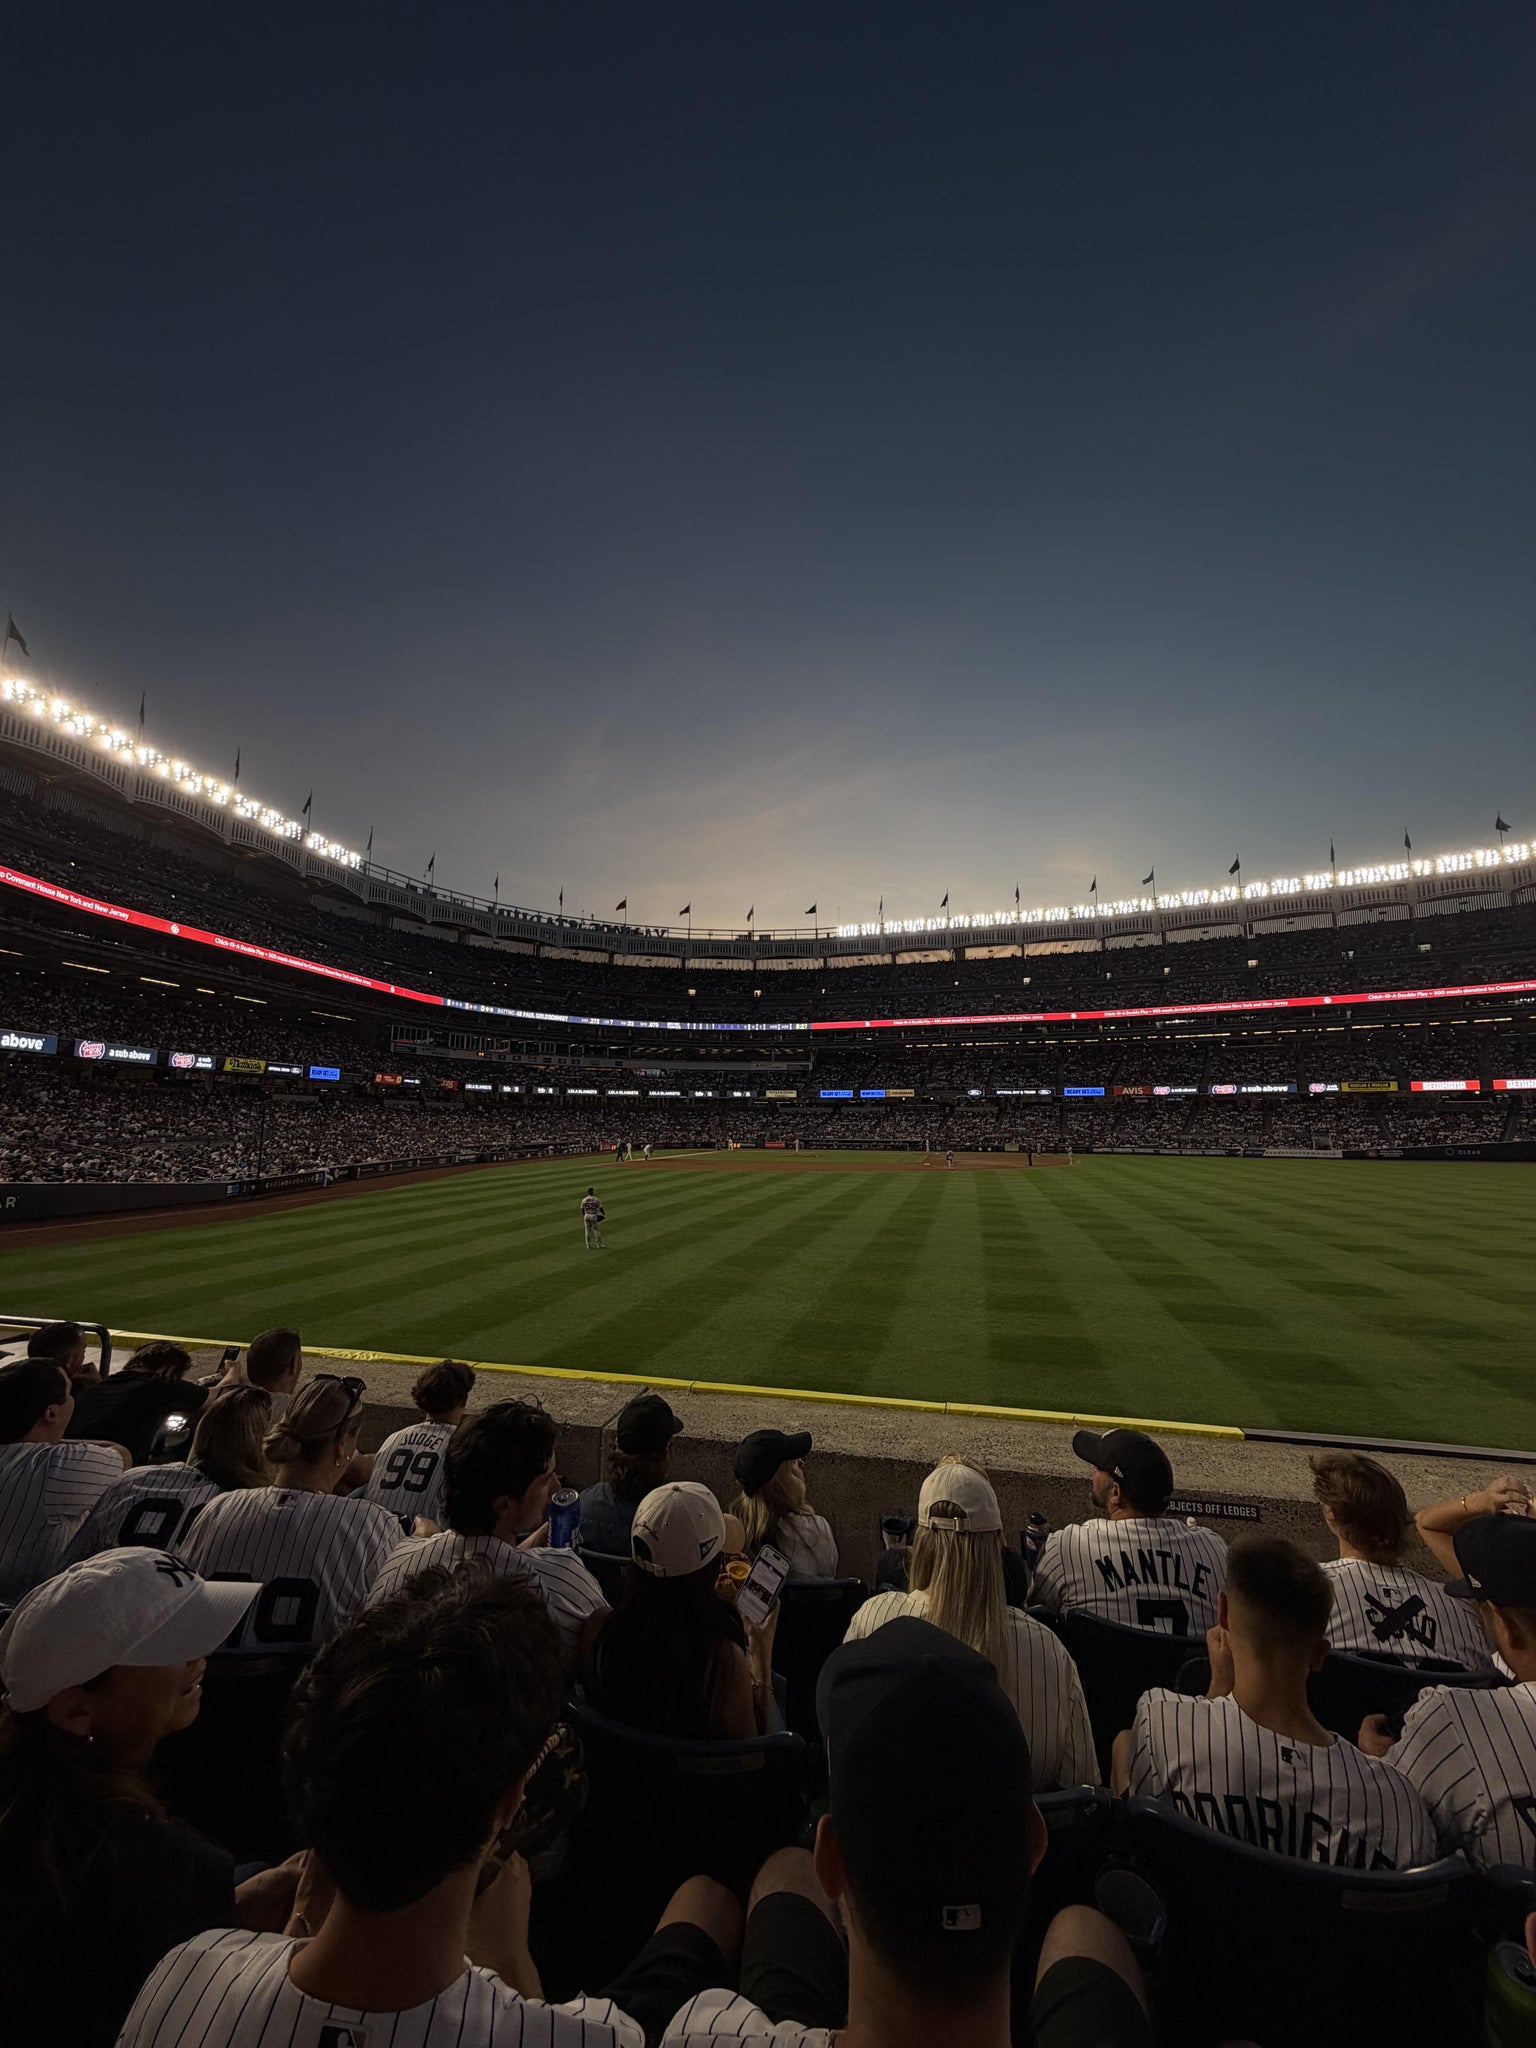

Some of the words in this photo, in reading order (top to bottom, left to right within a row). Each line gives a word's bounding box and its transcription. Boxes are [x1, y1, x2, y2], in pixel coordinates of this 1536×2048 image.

[37, 883, 56, 896] House
[56, 890, 69, 901] New
[94, 903, 108, 913] New
[108, 908, 129, 920] Jersey
[1, 1033, 44, 1051] above
[115, 1048, 128, 1059] sub
[128, 1050, 151, 1061] above
[1122, 1087, 1144, 1095] AVIS
[1248, 1085, 1262, 1093] sub
[1263, 1085, 1287, 1093] above
[401, 1433, 443, 1450] JUDGE
[380, 1448, 439, 1493] 99
[1167, 1500, 1203, 1513] BJECTS
[1206, 1504, 1221, 1515] OFF
[1224, 1505, 1257, 1518] LEDGES
[1095, 1549, 1211, 1600] MANTLE
